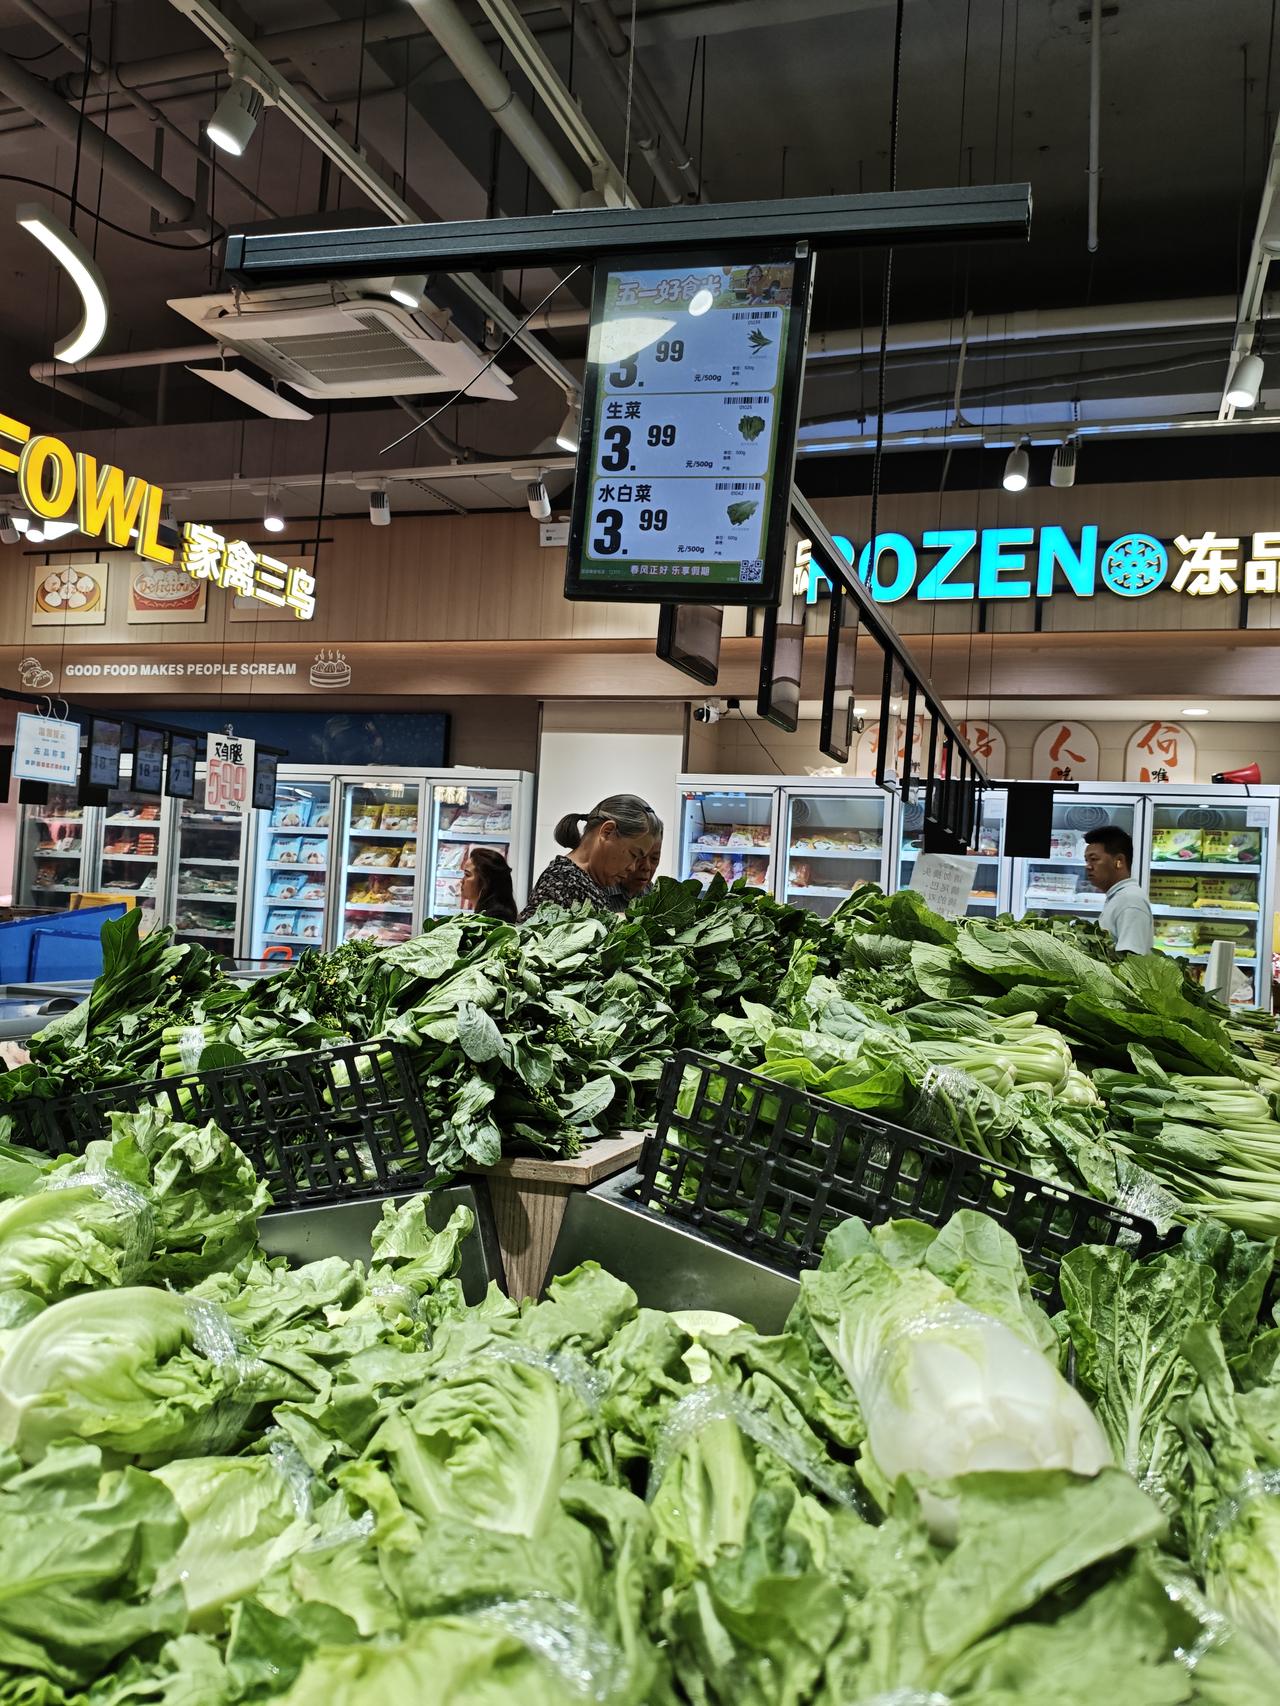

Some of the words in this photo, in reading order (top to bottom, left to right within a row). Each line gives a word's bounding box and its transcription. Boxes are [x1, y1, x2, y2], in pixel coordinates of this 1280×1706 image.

[655, 339, 684, 363] 99
[694, 374, 722, 383] 元/500g
[606, 401, 642, 420] 生菜
[601, 425, 636, 471] 3.
[647, 424, 677, 447] 99
[685, 460, 713, 469] 元/500g
[598, 484, 652, 503] 水白菜
[593, 509, 628, 555] 3.
[639, 509, 668, 531] 99
[677, 545, 705, 554] 元/500g
[181, 522, 317, 621] 家禽三鸟
[630, 565, 668, 575] 春风正好
[672, 565, 710, 576] 乐享假期
[65, 664, 101, 676] GOOD
[103, 664, 138, 676] FOOD
[140, 664, 184, 676] MAKES
[187, 663, 238, 675] PEOPLE
[240, 663, 297, 675] SCREAM
[1049, 725, 1086, 763] 人
[1136, 720, 1181, 768] 何
